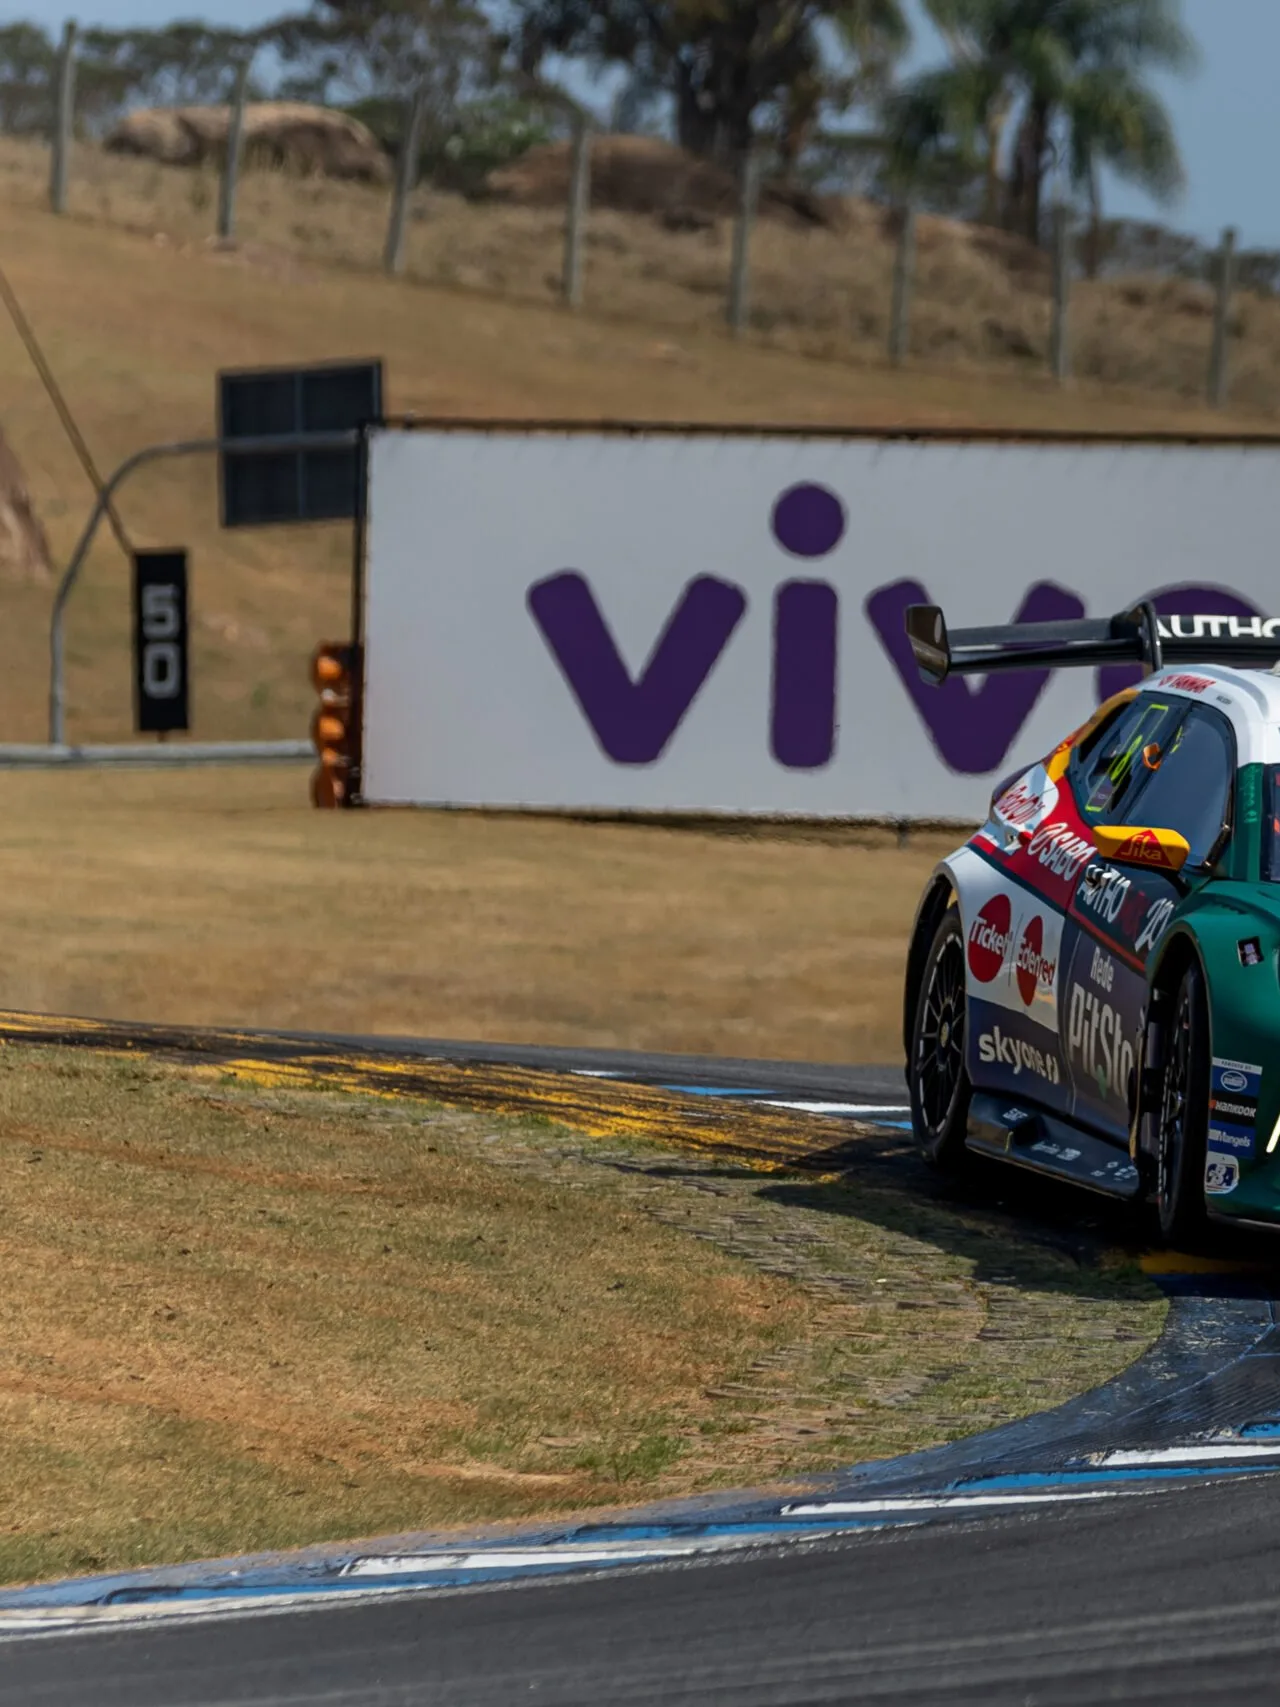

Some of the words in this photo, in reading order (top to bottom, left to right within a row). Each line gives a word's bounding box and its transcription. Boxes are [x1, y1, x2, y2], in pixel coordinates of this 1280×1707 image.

[142, 584, 181, 699] 50
[526, 481, 1265, 774] viv
[1119, 834, 1163, 862] Sika
[970, 917, 1013, 958] Ticket
[1016, 936, 1056, 987] Edenred
[1068, 982, 1139, 1105] PitSto
